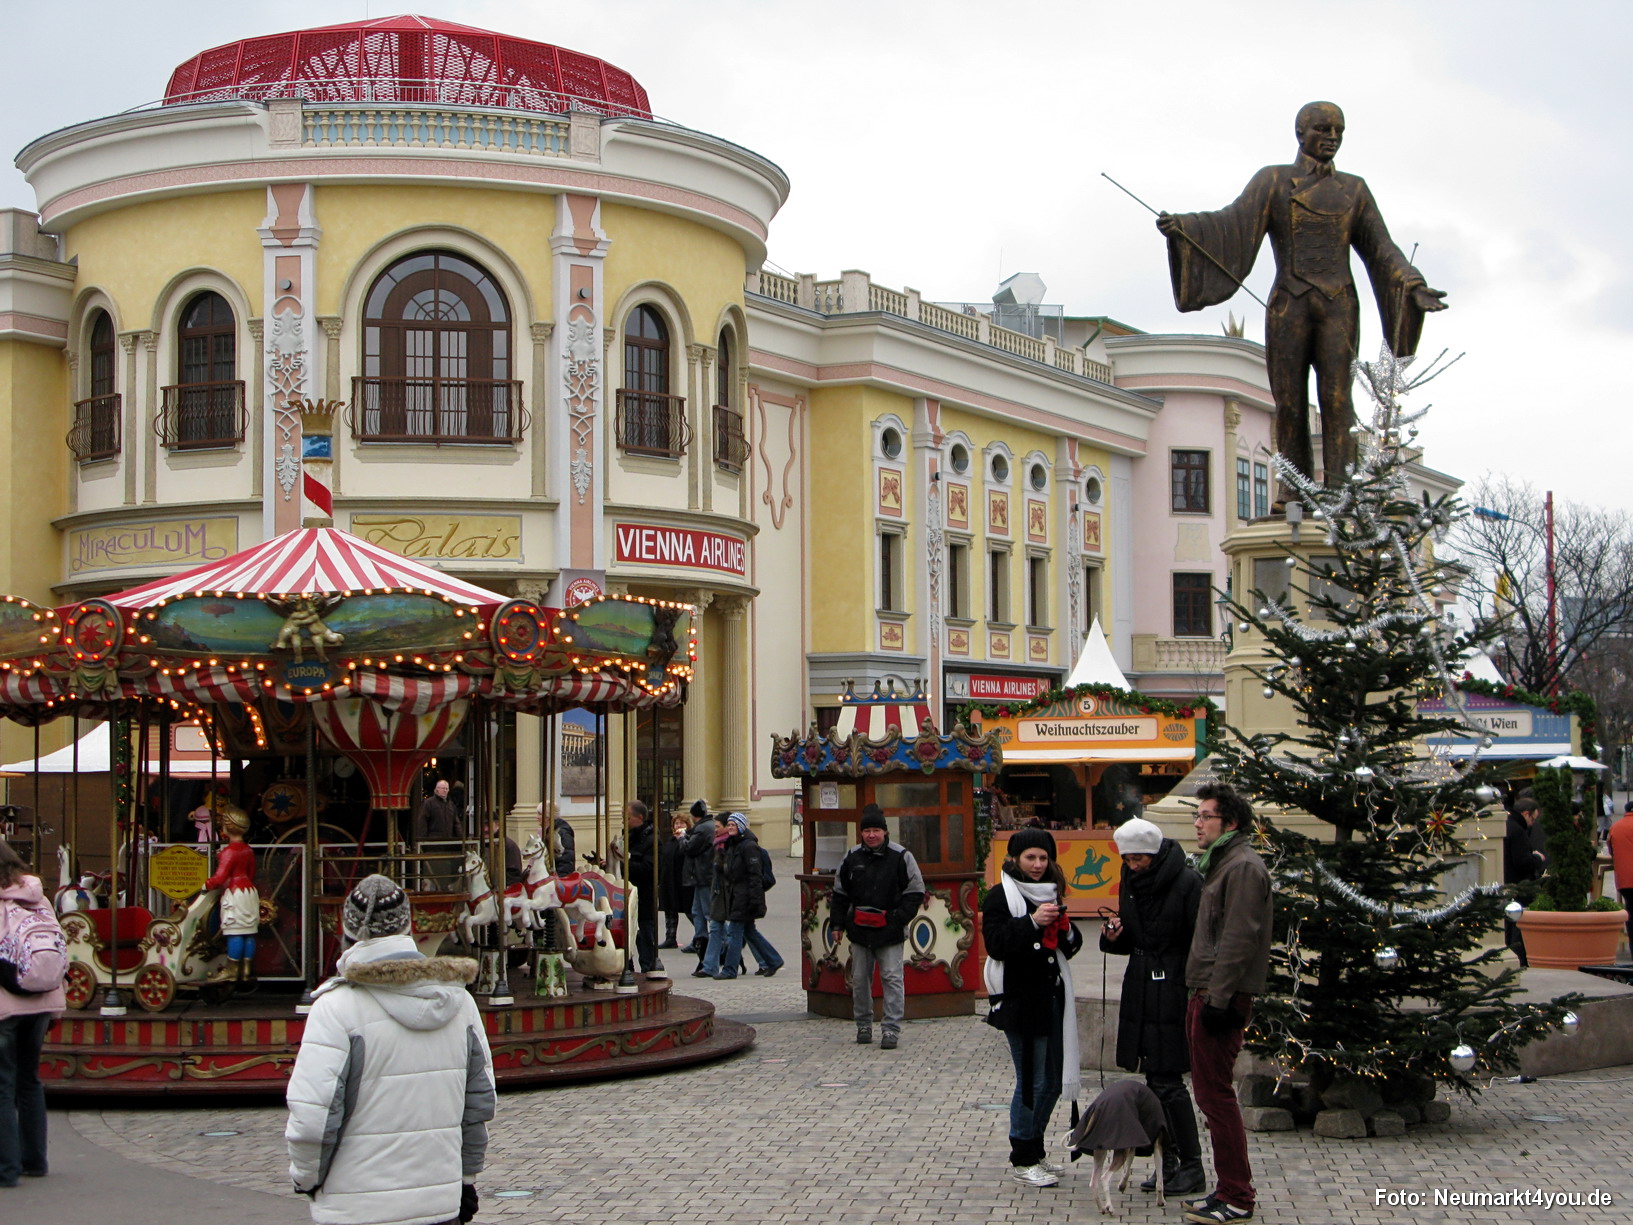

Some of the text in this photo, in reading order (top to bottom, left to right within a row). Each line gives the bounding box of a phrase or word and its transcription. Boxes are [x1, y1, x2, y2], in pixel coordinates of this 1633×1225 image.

[352, 515, 519, 557] Palais
[72, 523, 227, 571] MIRACULUM
[617, 527, 745, 572] VIENNA AIRLINES
[288, 666, 326, 678] EUROPA
[971, 679, 1036, 695] VIENNA AIRLINES
[1083, 700, 1091, 710] 5
[1034, 722, 1140, 736] Weihnachtszauber
[1491, 718, 1518, 729] Wien
